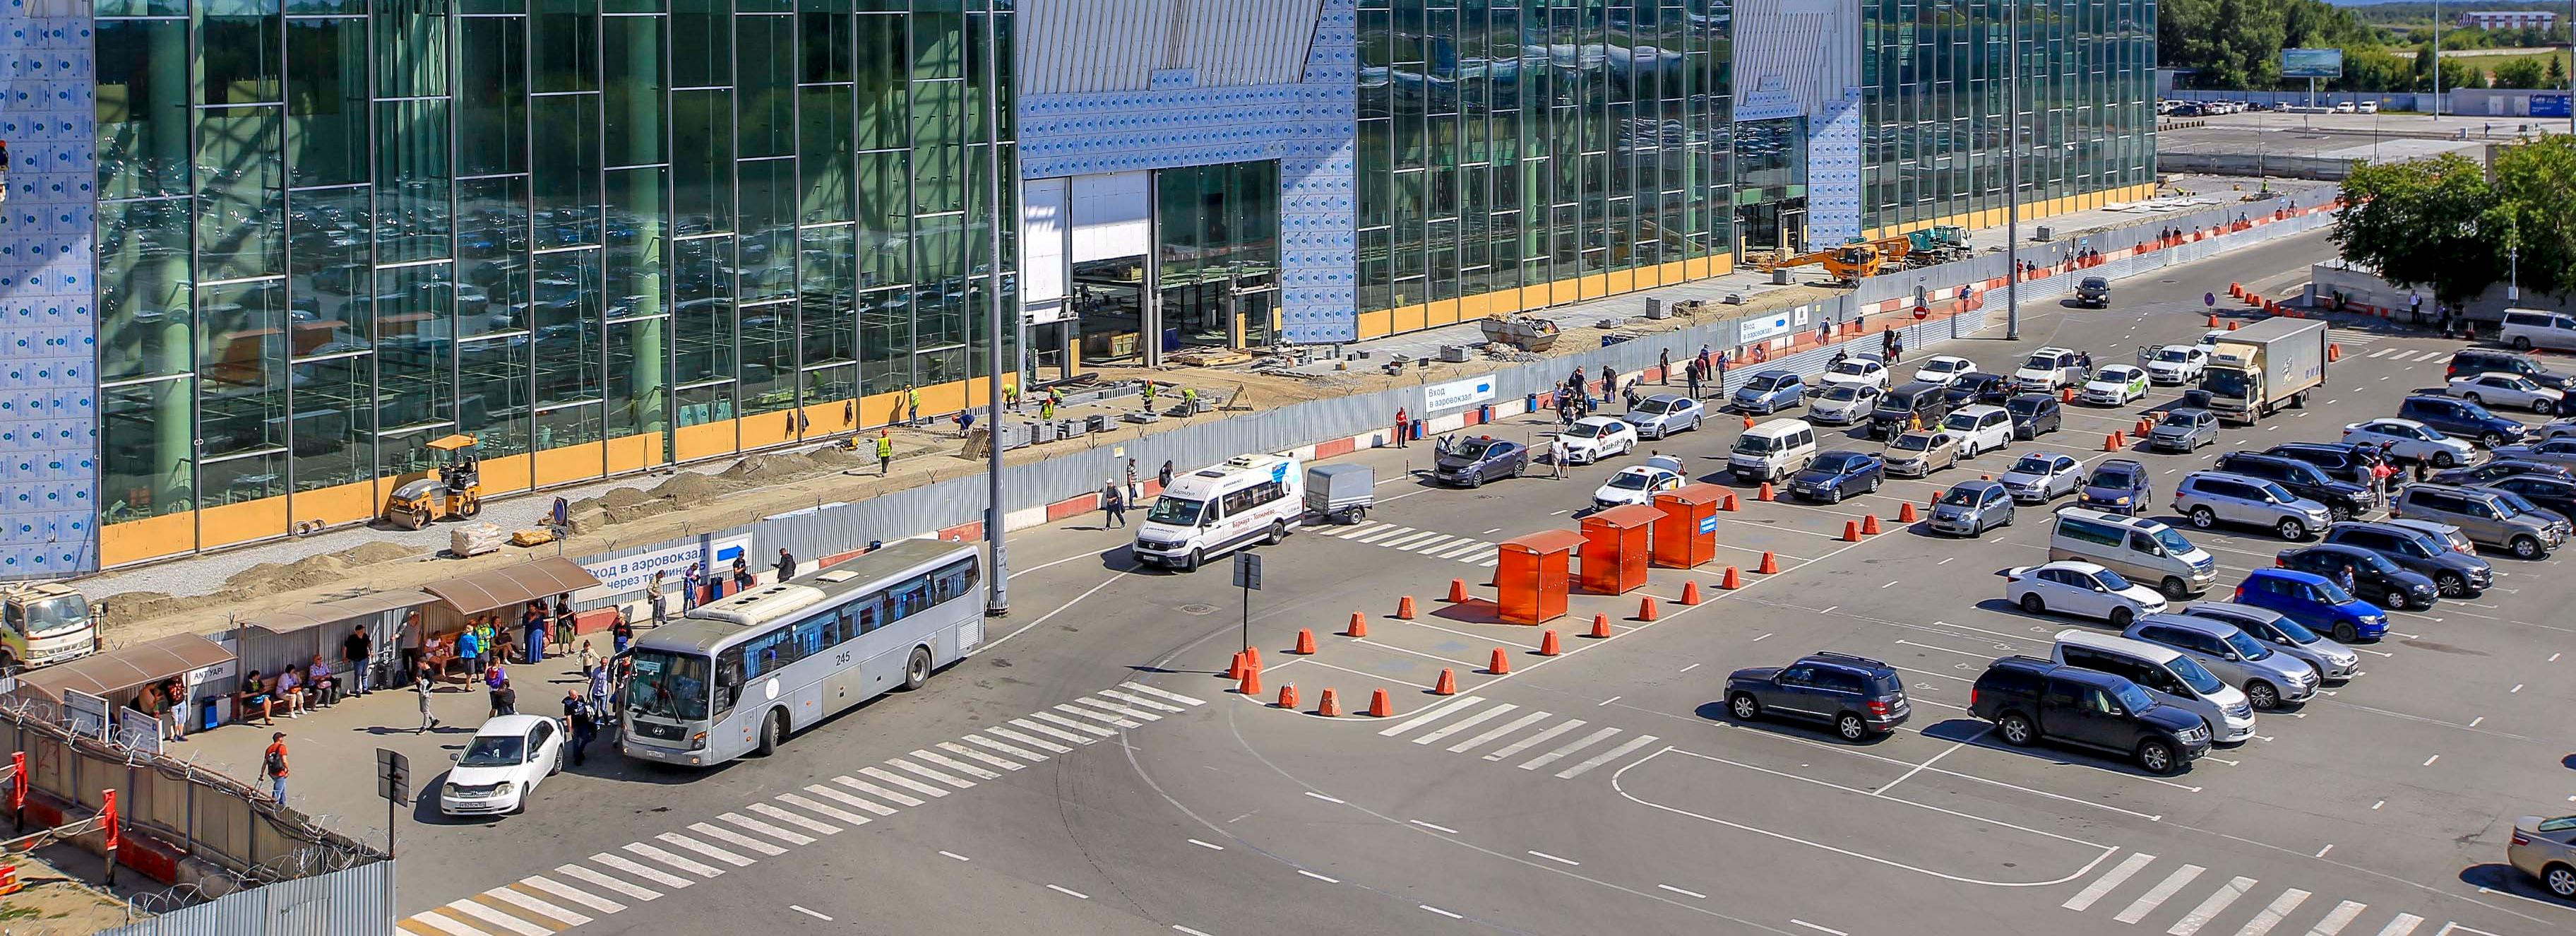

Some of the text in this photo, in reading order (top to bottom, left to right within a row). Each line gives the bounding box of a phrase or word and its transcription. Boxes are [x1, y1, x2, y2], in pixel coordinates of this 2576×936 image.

[1748, 327, 1772, 339] аэровокзал
[1429, 388, 1445, 397] Вход
[1435, 393, 1472, 408] аэровокзал
[1232, 518, 1250, 528] Барнаул
[621, 564, 628, 574] в
[632, 548, 706, 571] аэровокзал
[607, 576, 640, 590] через
[699, 560, 706, 571] Б
[836, 651, 850, 666] 245
[194, 667, 224, 680] ANT YAPI
